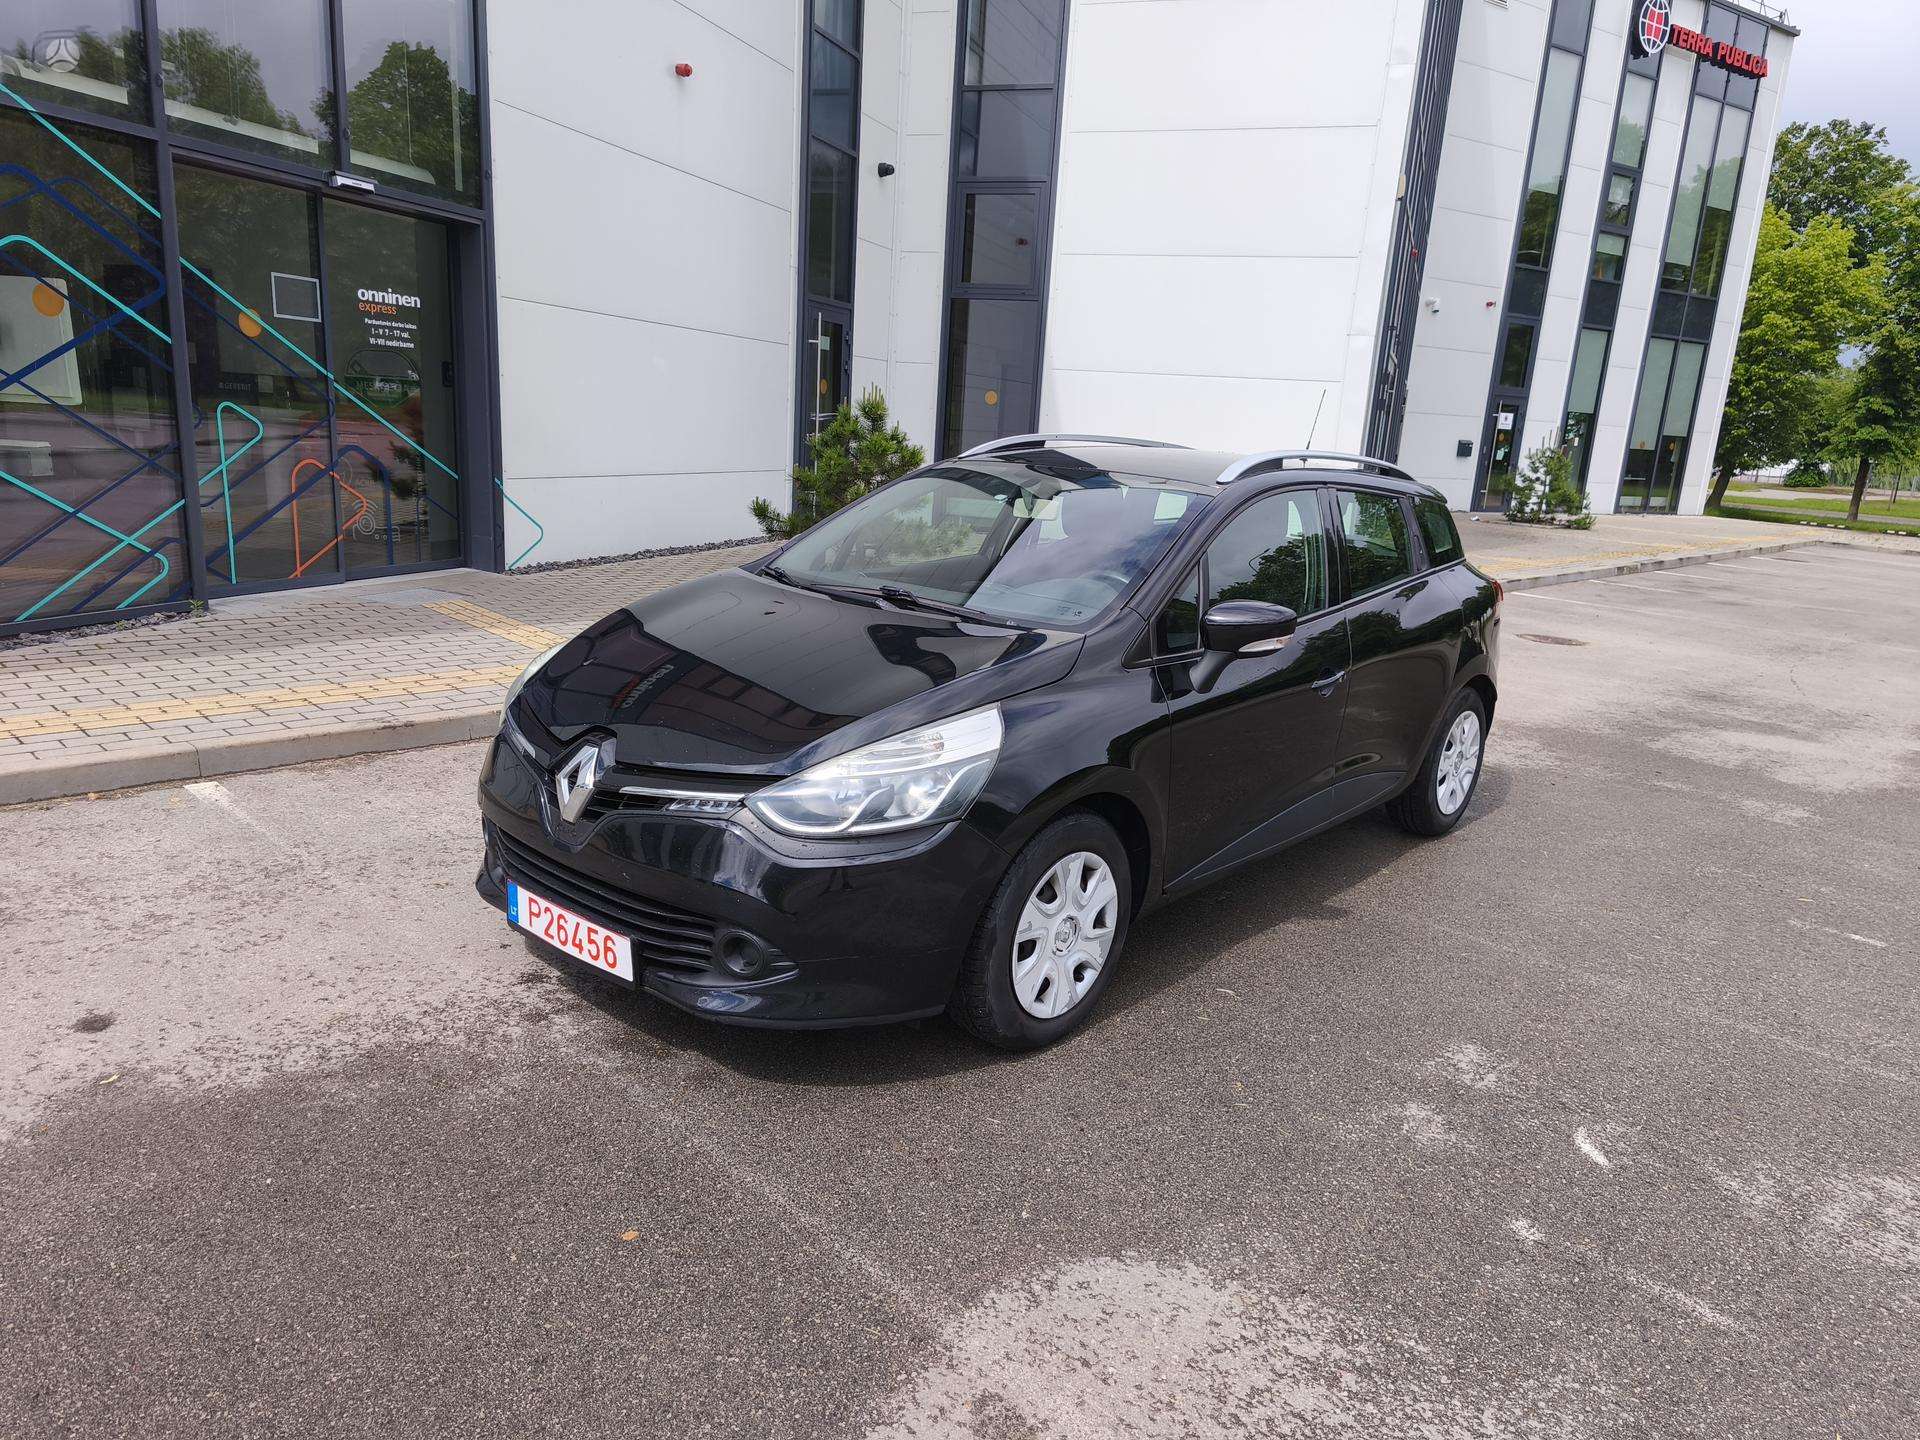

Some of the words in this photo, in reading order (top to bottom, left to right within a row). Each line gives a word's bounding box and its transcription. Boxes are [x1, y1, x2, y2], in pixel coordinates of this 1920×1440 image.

[1672, 24, 1713, 57] TERRA
[1717, 42, 1768, 77] PUBLICA
[357, 288, 421, 308] onninen
[358, 302, 397, 315] express
[528, 896, 618, 969] P26456
